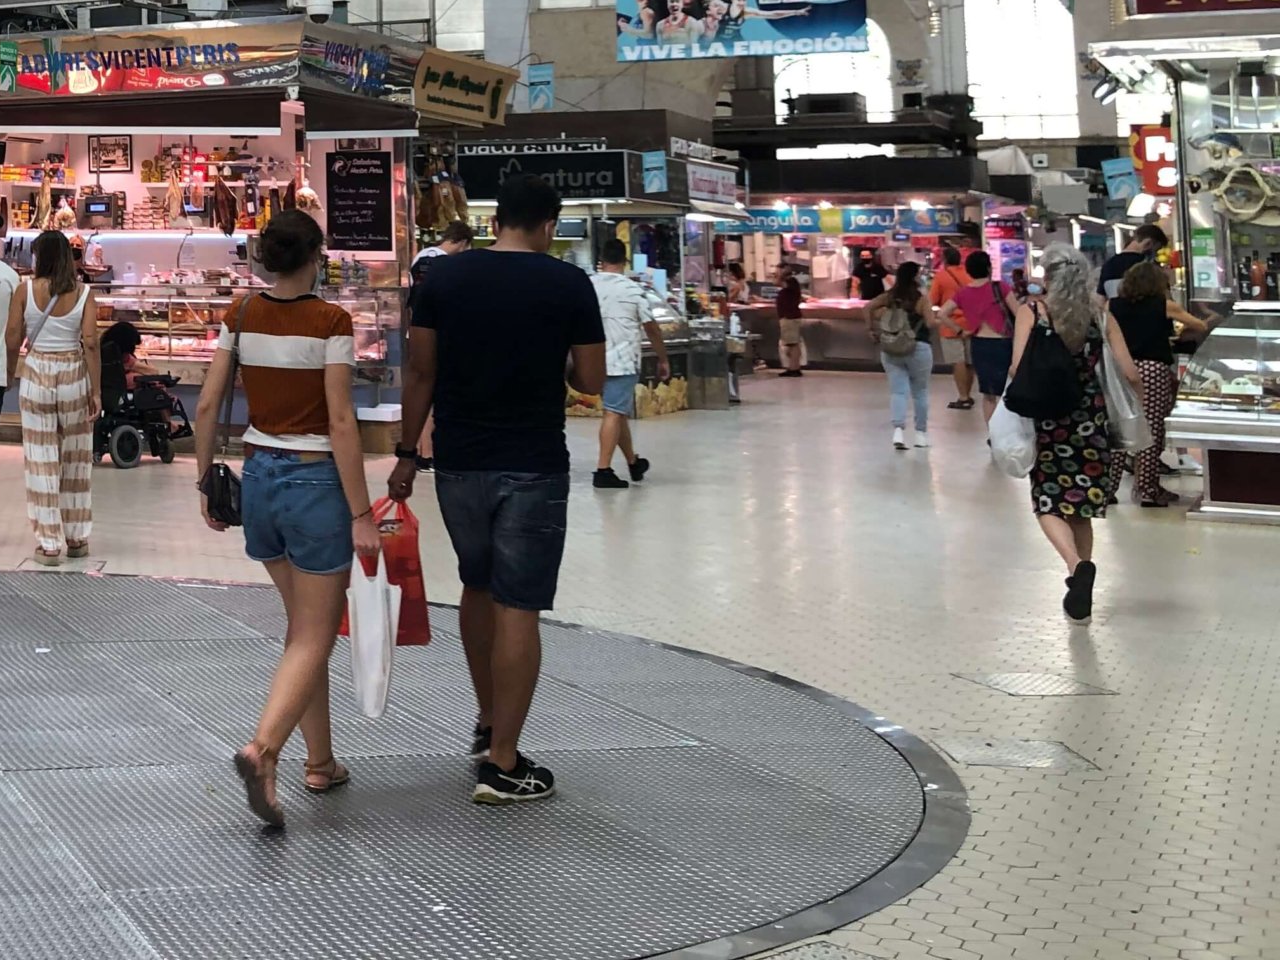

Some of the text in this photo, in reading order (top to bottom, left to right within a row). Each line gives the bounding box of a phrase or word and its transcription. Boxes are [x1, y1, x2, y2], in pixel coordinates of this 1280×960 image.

[623, 32, 867, 60] VIVE LA EMOCIÓN
[540, 169, 614, 187] atura
